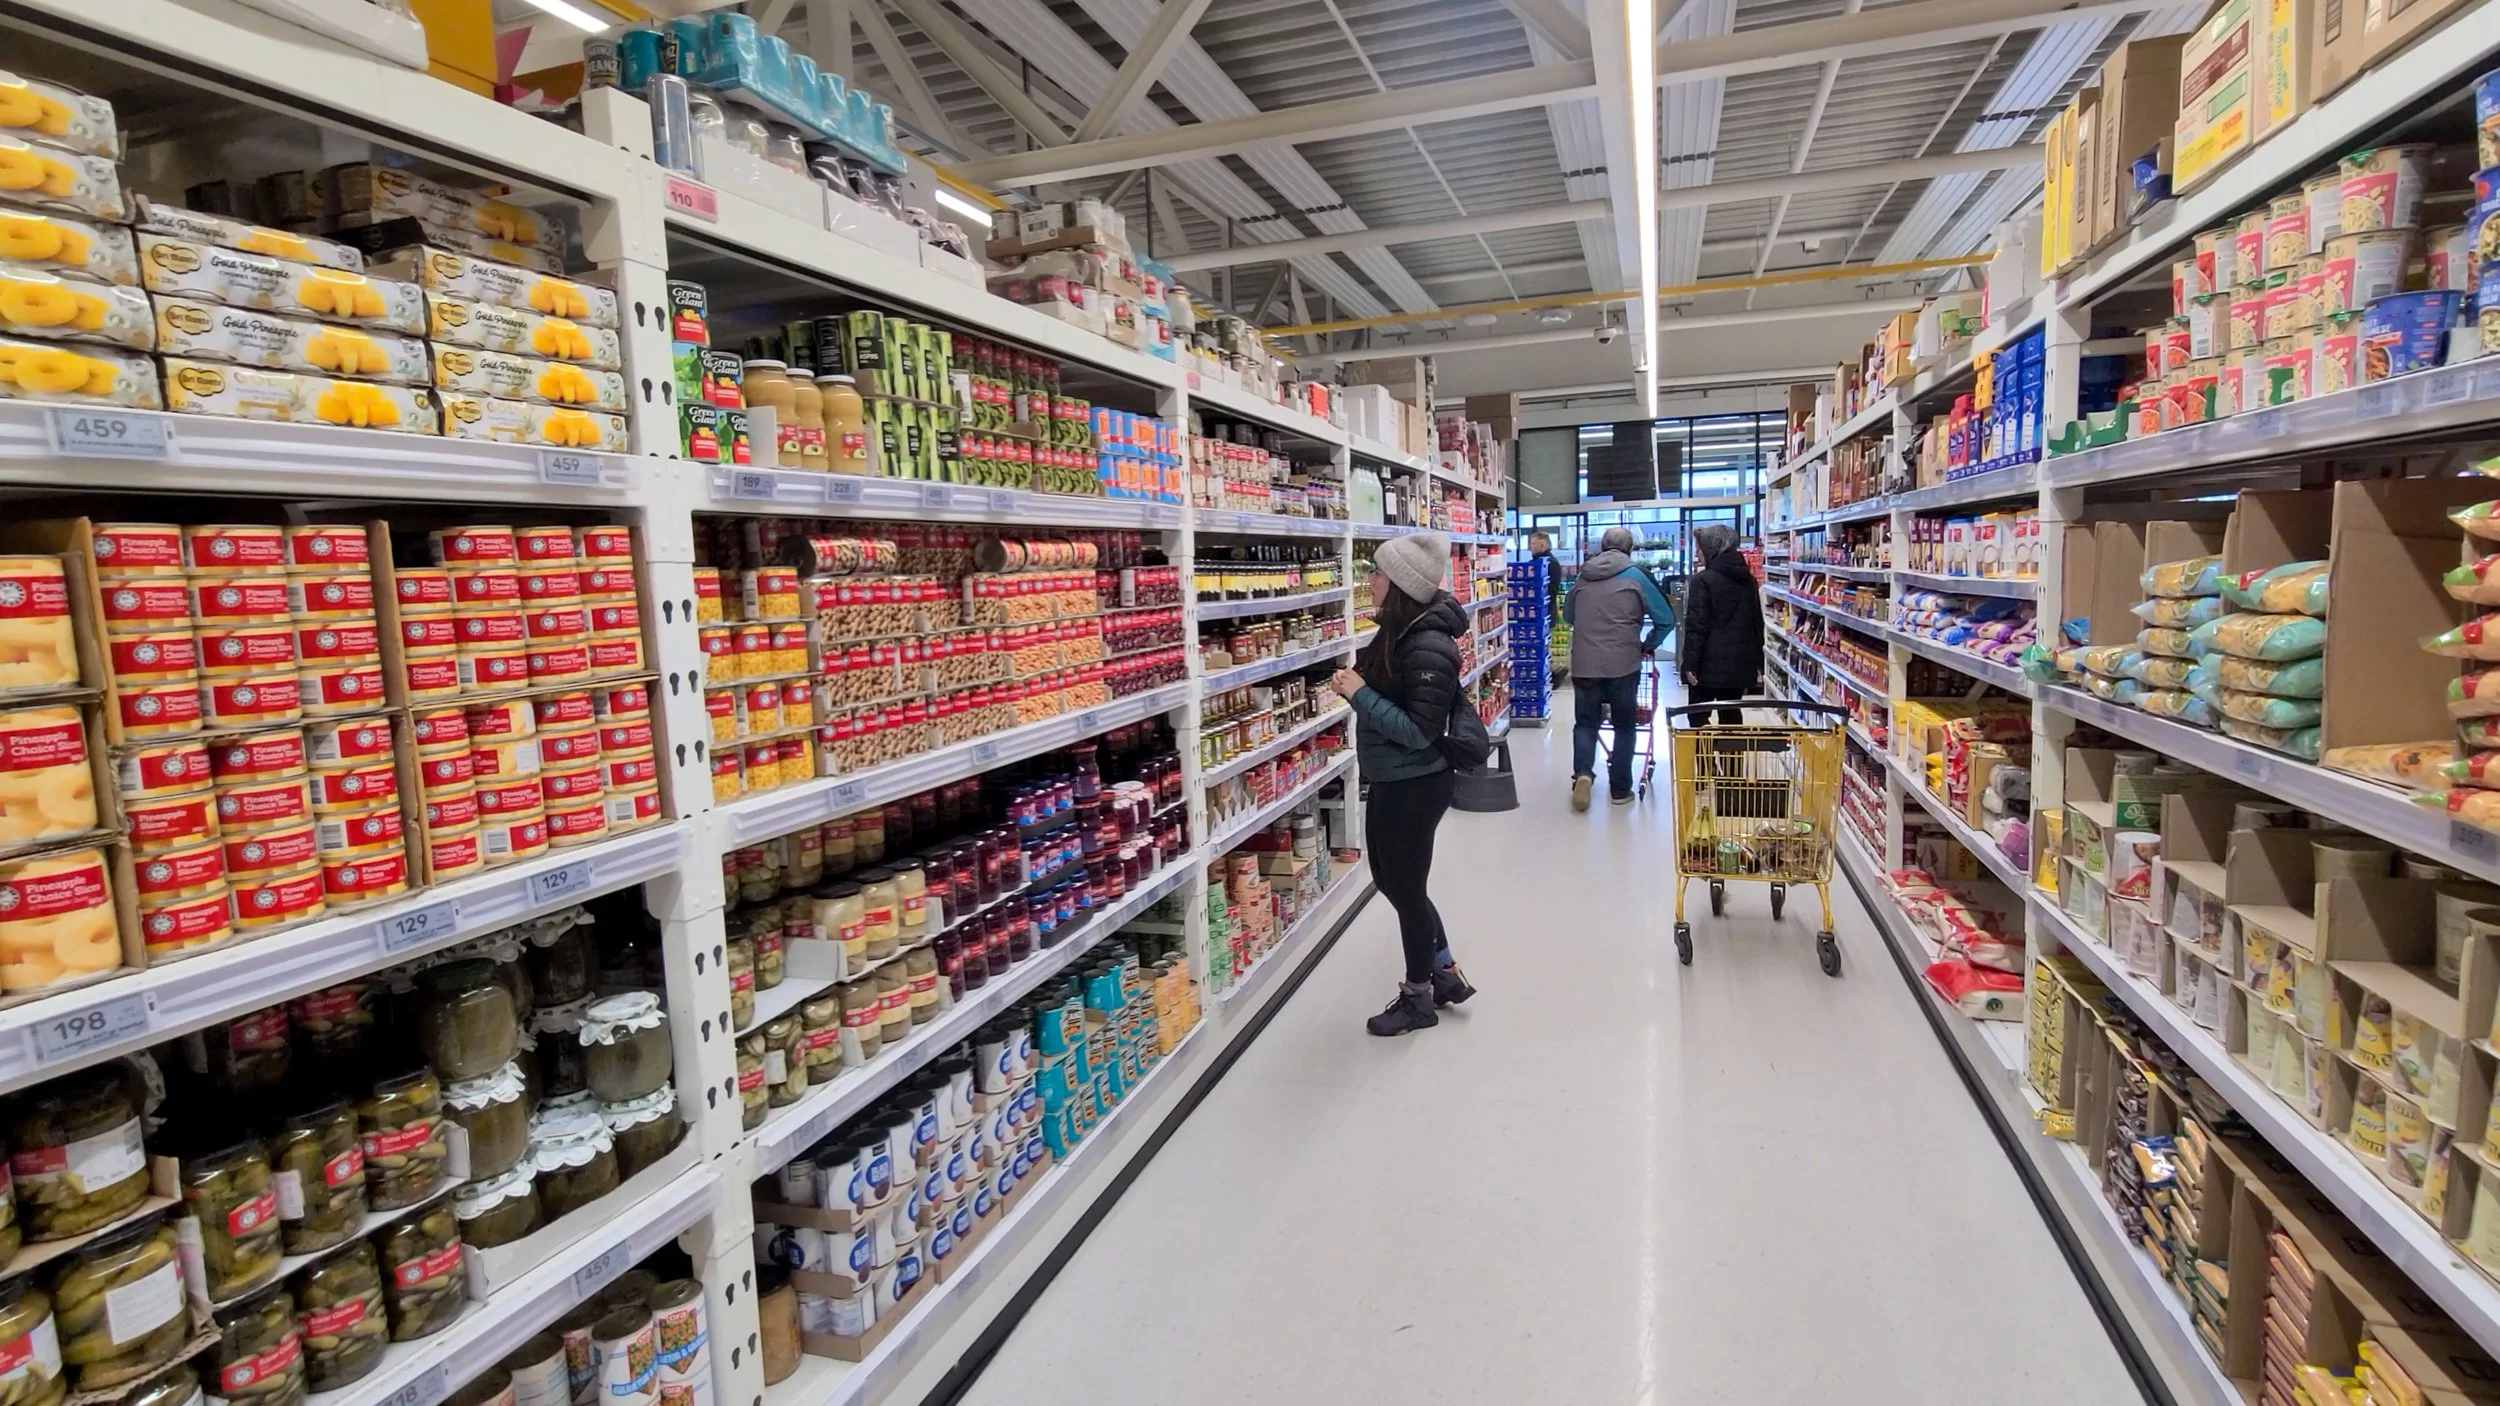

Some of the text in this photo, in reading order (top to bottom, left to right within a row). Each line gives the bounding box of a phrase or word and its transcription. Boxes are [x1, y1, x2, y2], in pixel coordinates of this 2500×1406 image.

[671, 191, 692, 207] 110
[672, 287, 702, 300] Green
[675, 297, 703, 308] Giant
[710, 357, 738, 368] Green
[712, 366, 739, 376] Giant
[688, 406, 716, 418] Green
[691, 413, 716, 425] Giant
[74, 418, 127, 439] 459
[553, 457, 580, 471] 459
[10, 731, 68, 746] Pineapple
[10, 744, 56, 756] Choice
[25, 876, 87, 894] Pineapple
[542, 871, 569, 890] 129
[27, 890, 73, 904] Choice
[395, 913, 428, 936] 129
[53, 1011, 107, 1040] 198
[584, 1255, 611, 1281] 459
